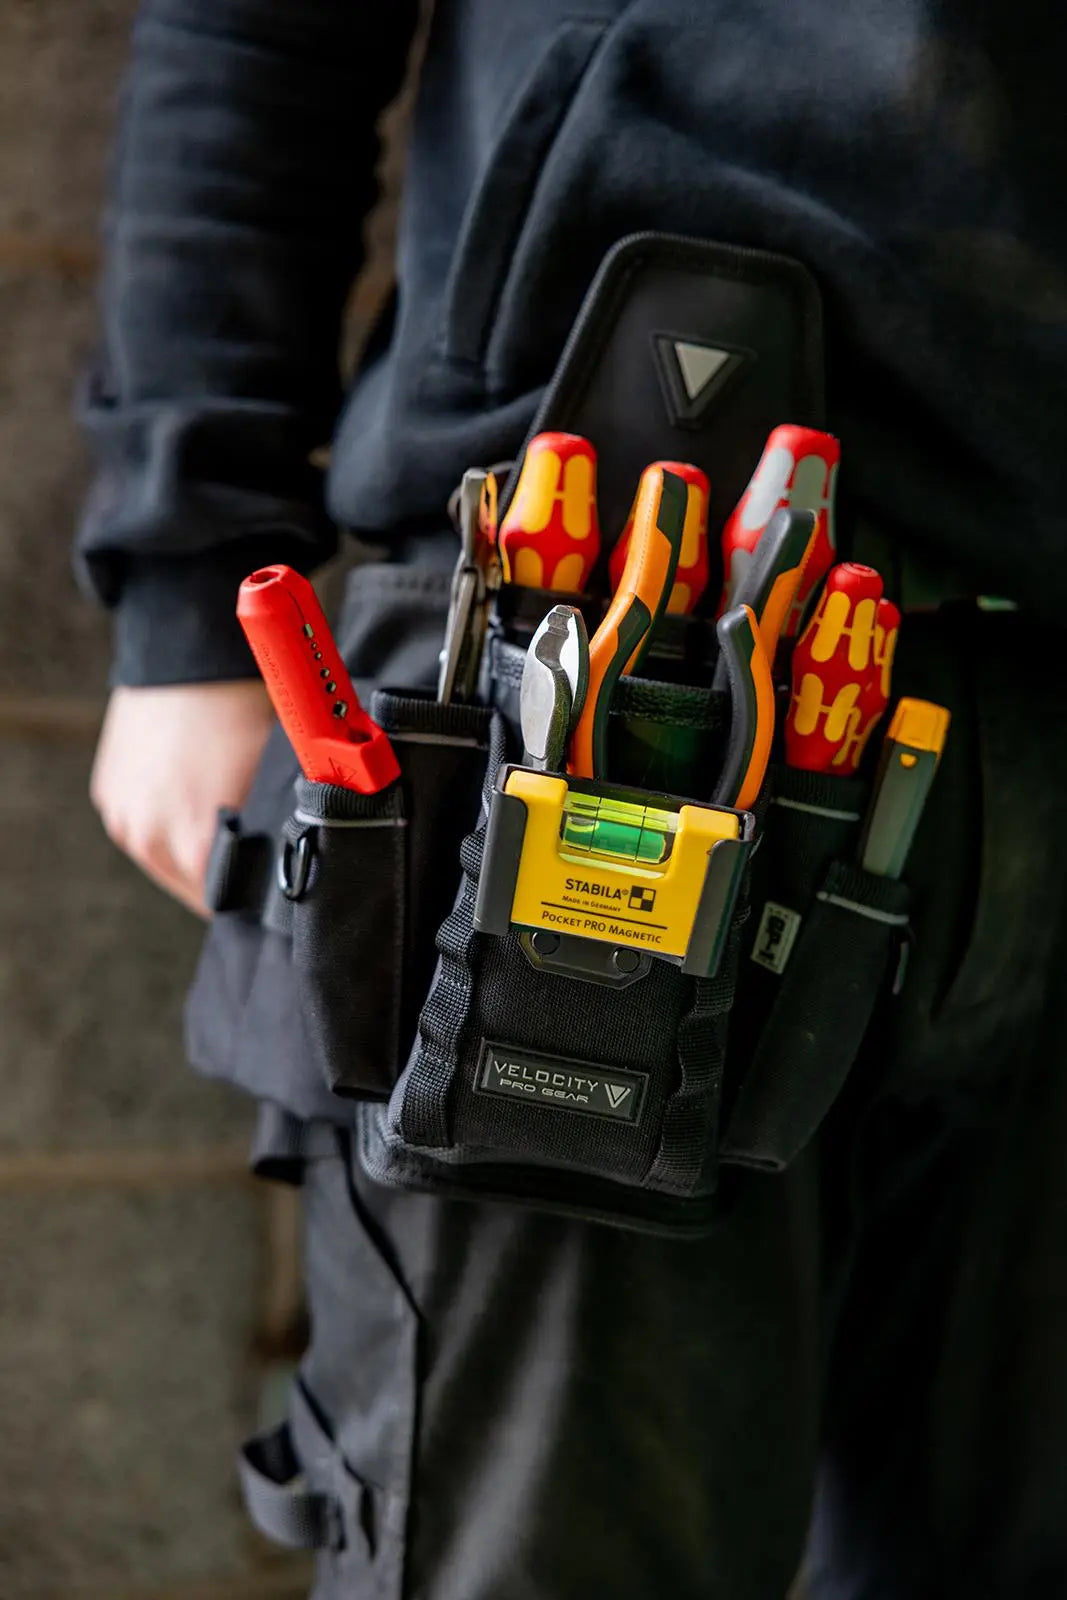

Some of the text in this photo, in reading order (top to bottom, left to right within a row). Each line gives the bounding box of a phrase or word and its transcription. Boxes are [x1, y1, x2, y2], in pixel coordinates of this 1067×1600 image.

[583, 919, 606, 932] PRO
[494, 1060, 598, 1092] VELOCITY
[499, 1078, 588, 1103] PRO GEAR
